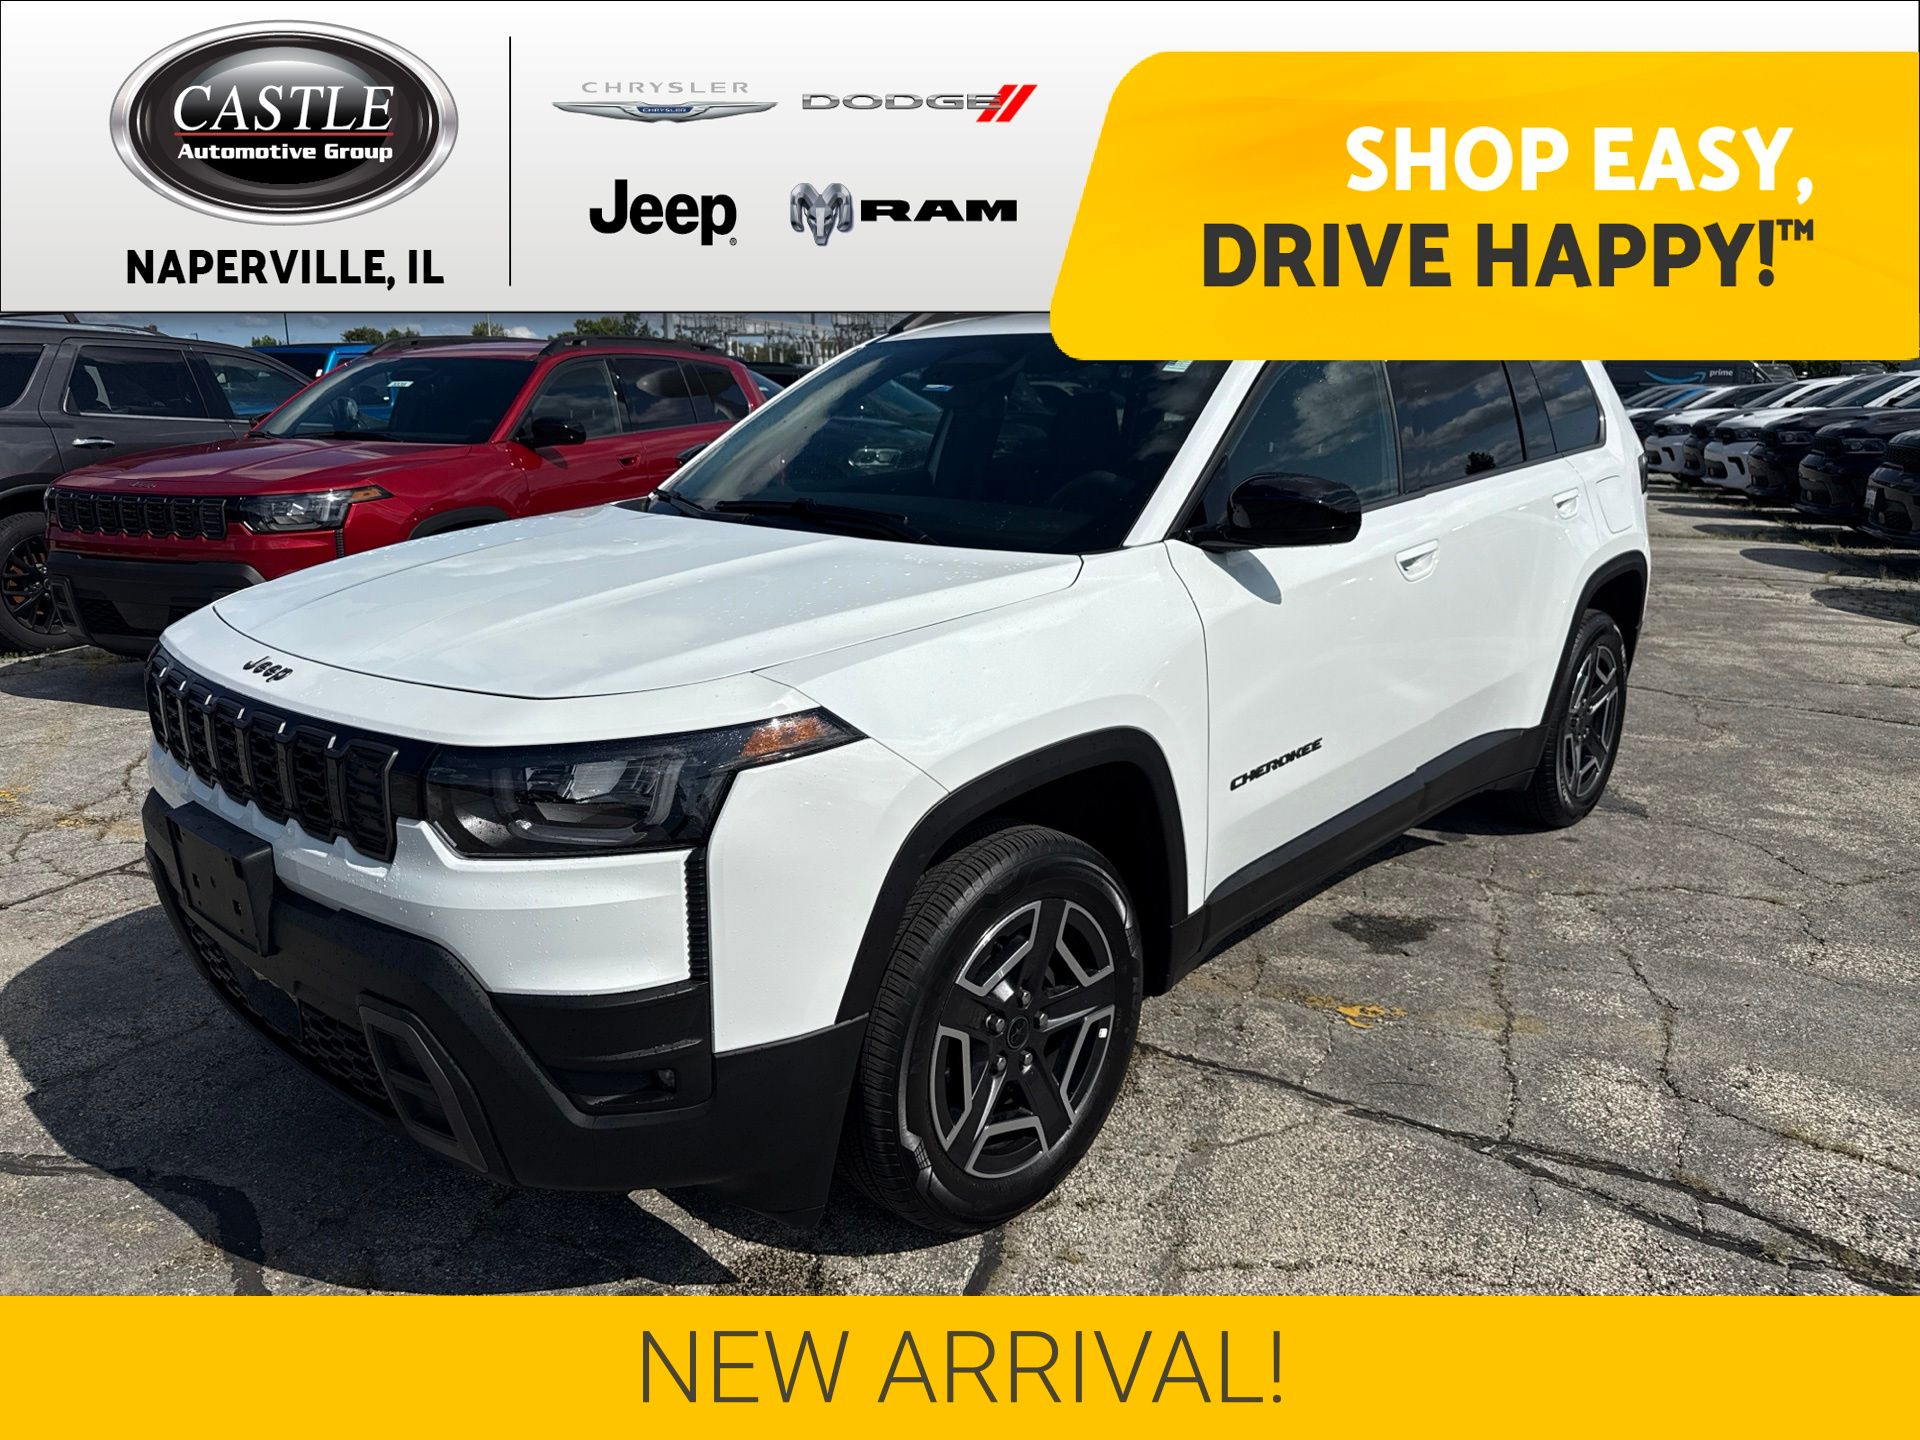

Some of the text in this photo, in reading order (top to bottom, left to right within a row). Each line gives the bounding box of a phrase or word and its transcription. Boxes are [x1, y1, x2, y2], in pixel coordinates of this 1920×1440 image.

[1709, 369, 1734, 378] prime
[243, 655, 294, 683] Jeep
[1230, 737, 1323, 791] CHEROKEE
